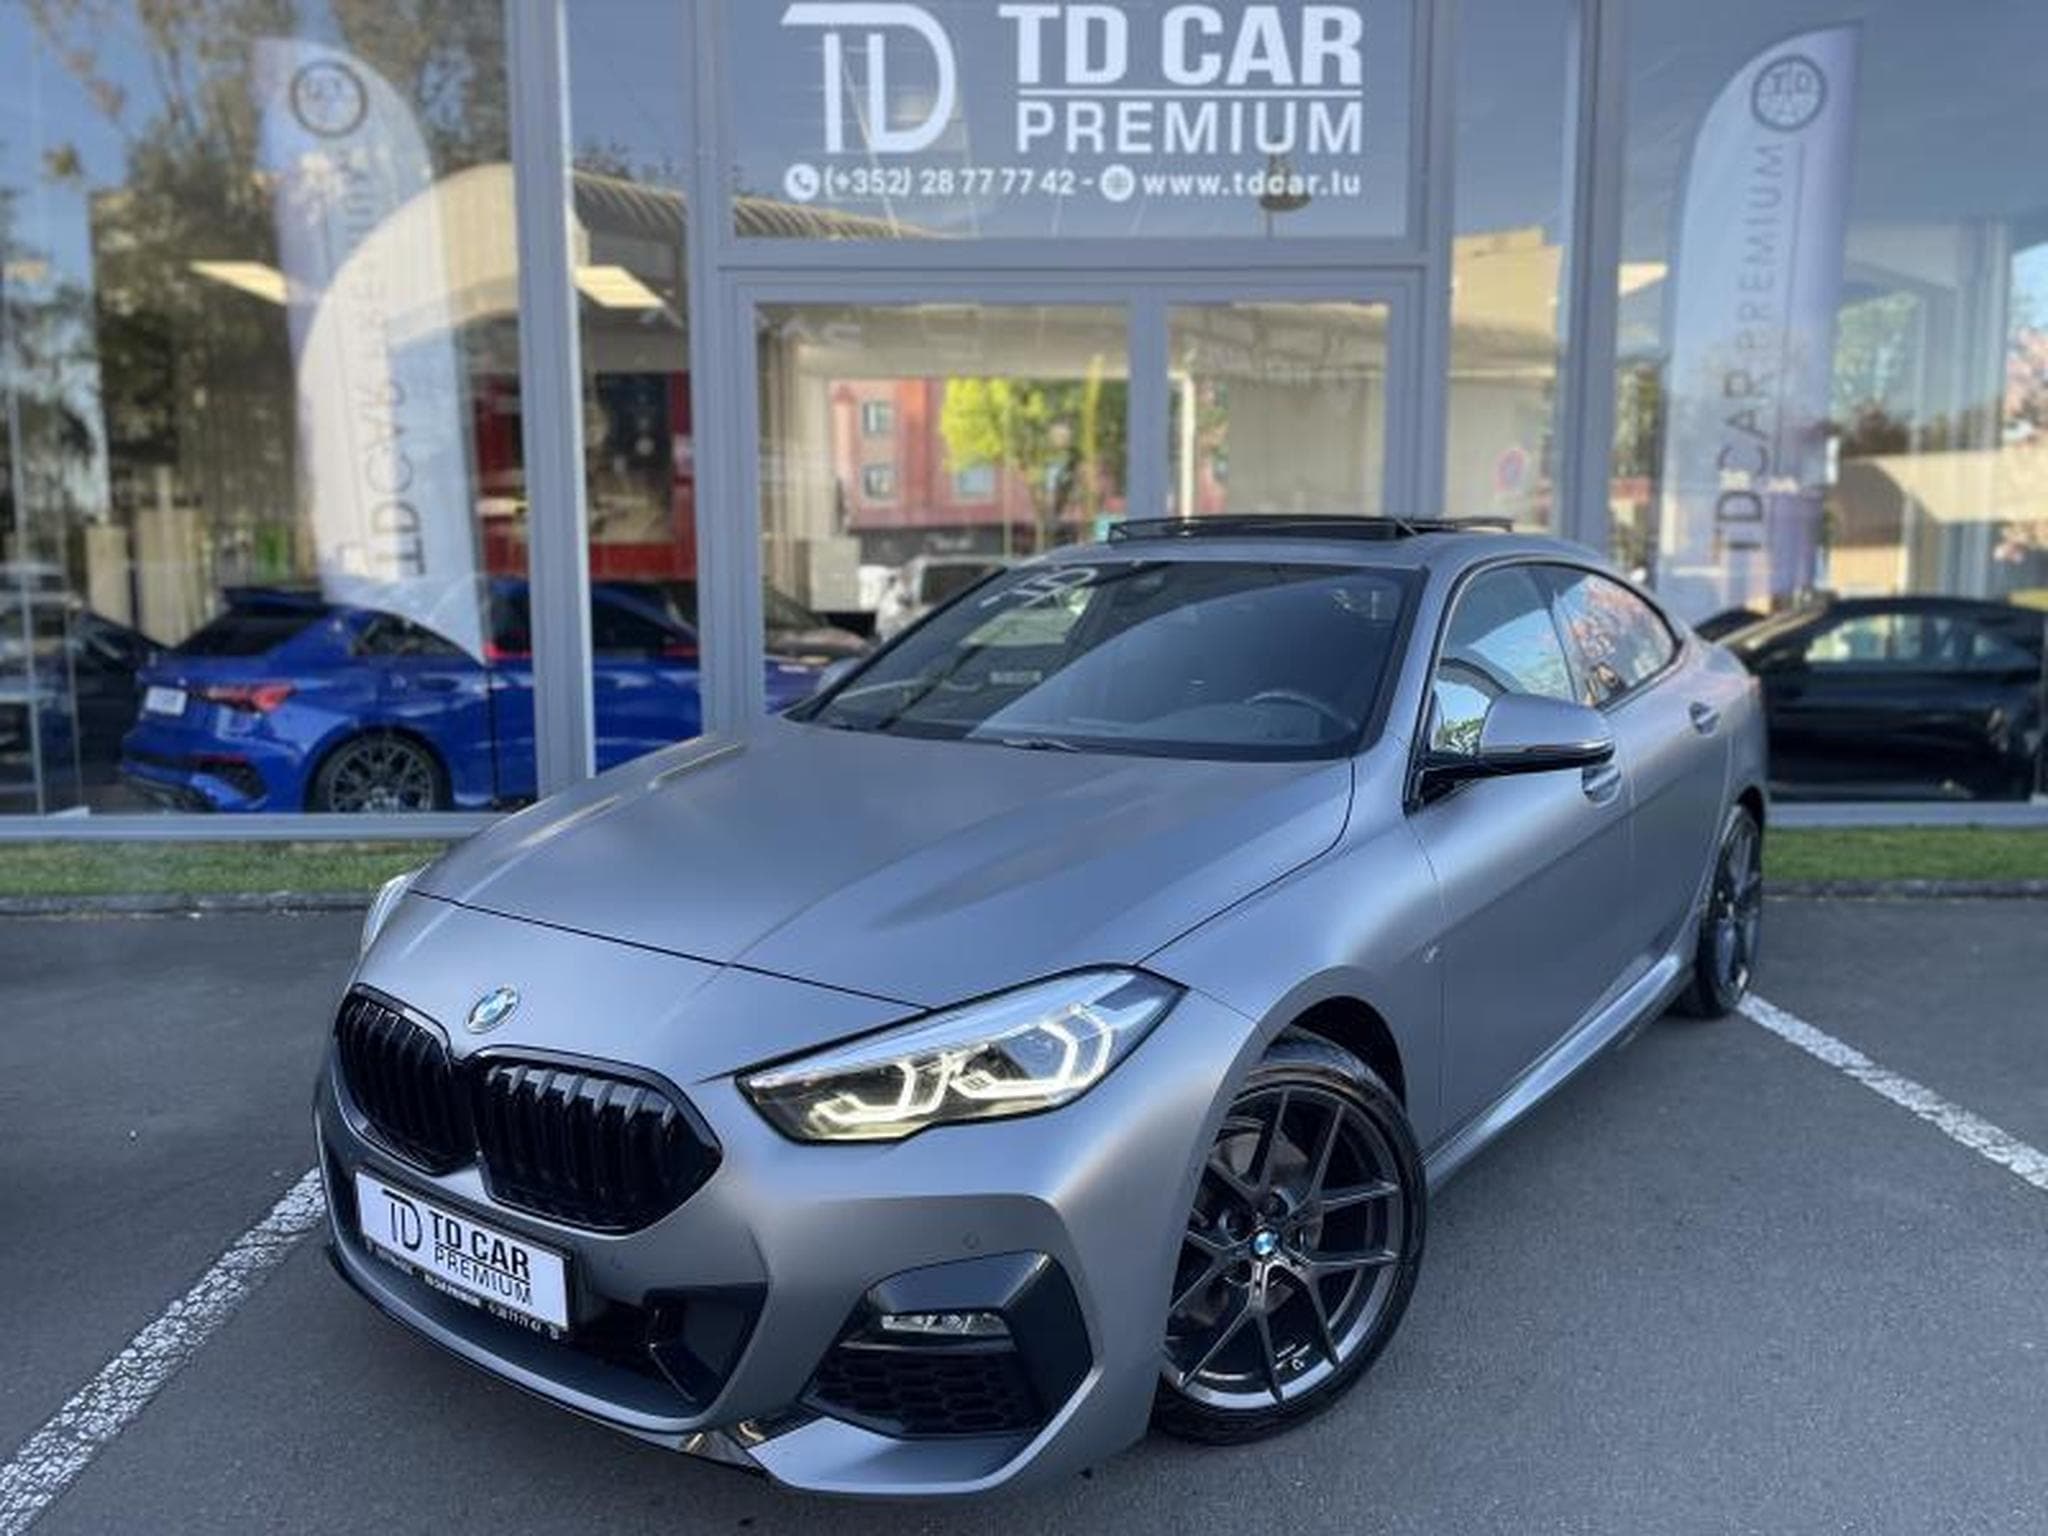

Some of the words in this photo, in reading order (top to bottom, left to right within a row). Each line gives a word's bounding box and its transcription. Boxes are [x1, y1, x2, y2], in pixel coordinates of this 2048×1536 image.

[999, 4, 1128, 84] TD
[1162, 5, 1363, 85] CAR
[1018, 101, 1363, 154] PREMIUM
[825, 166, 911, 196] (+352)
[921, 168, 954, 195] 28
[960, 168, 994, 195] 77
[1001, 168, 1034, 195] 77
[1040, 168, 1076, 195] 42
[1142, 171, 1361, 196] www.tdcar.lu
[429, 1211, 461, 1249] TD
[471, 1231, 530, 1280] CAR
[435, 1247, 532, 1306] PREMIUM
